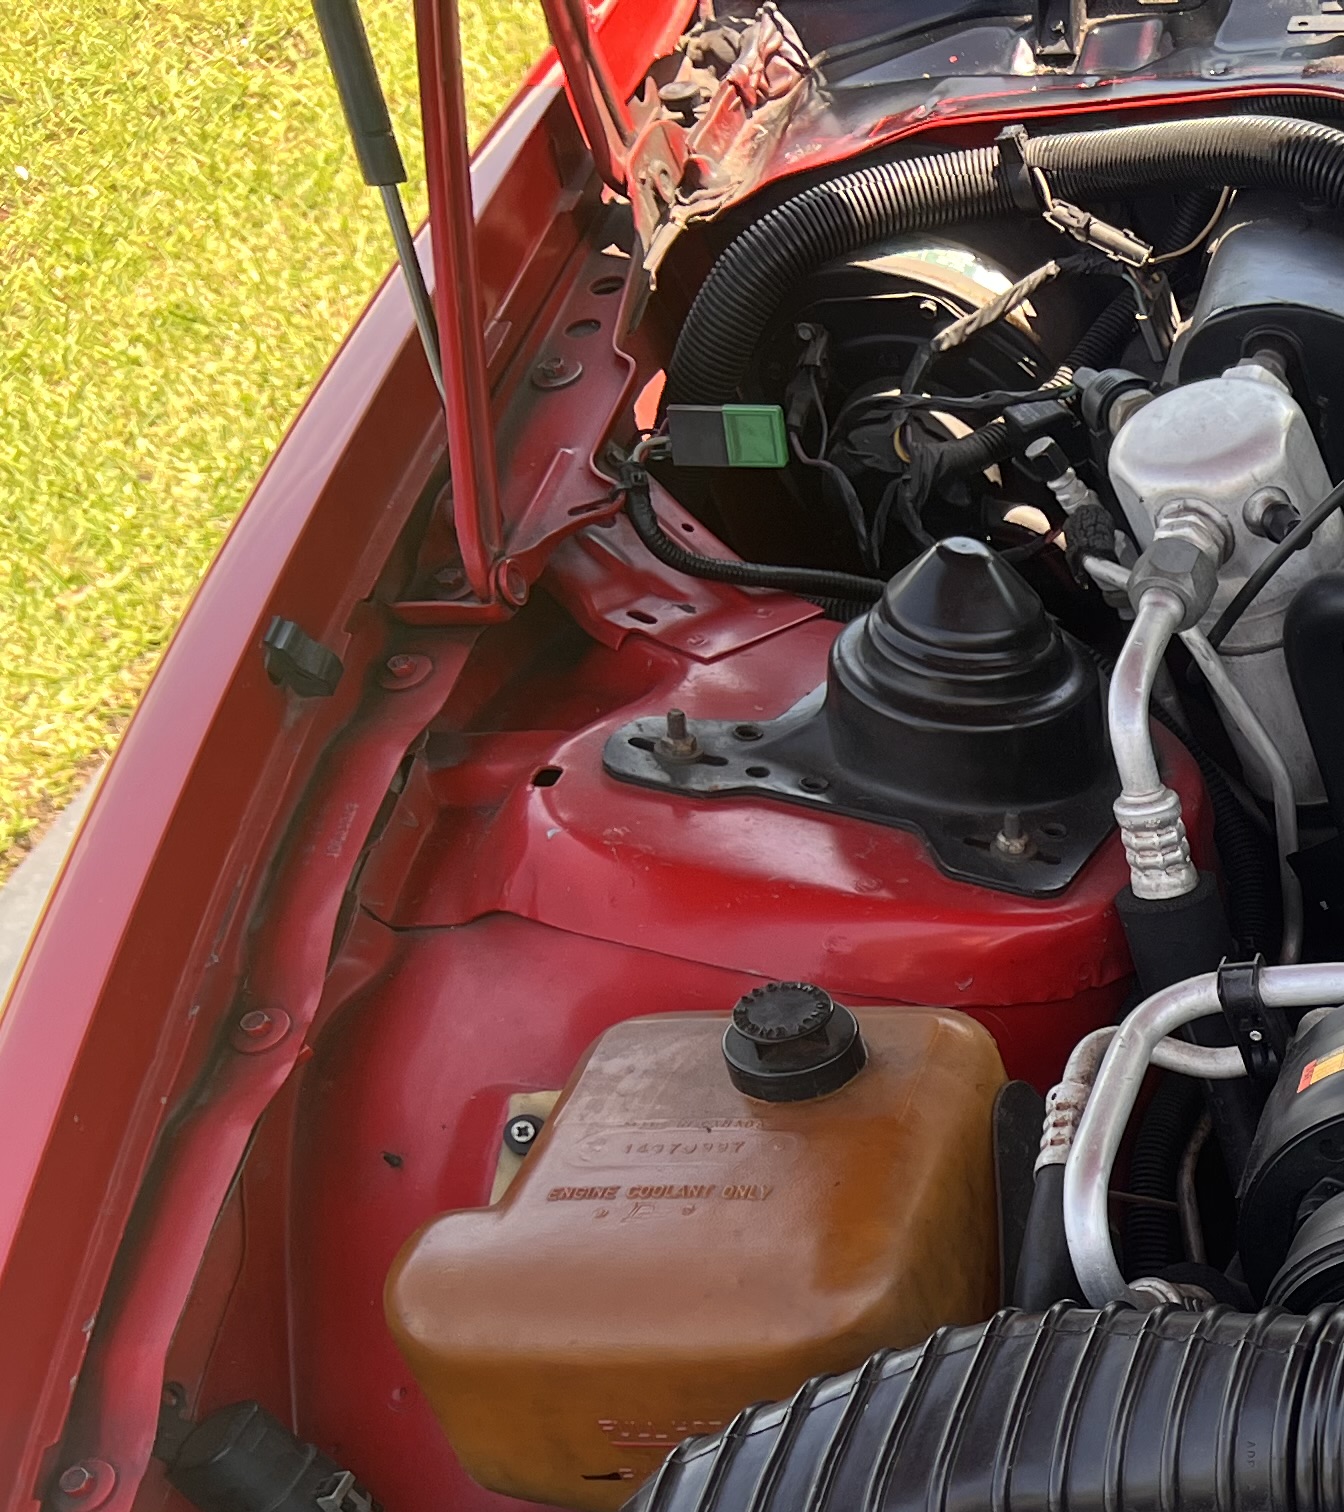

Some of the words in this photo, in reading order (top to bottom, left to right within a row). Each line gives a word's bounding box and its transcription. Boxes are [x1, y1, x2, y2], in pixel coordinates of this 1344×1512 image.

[546, 1185, 622, 1204] ENGINE
[625, 1184, 717, 1200] COOLANT
[721, 1184, 775, 1200] ONLY
